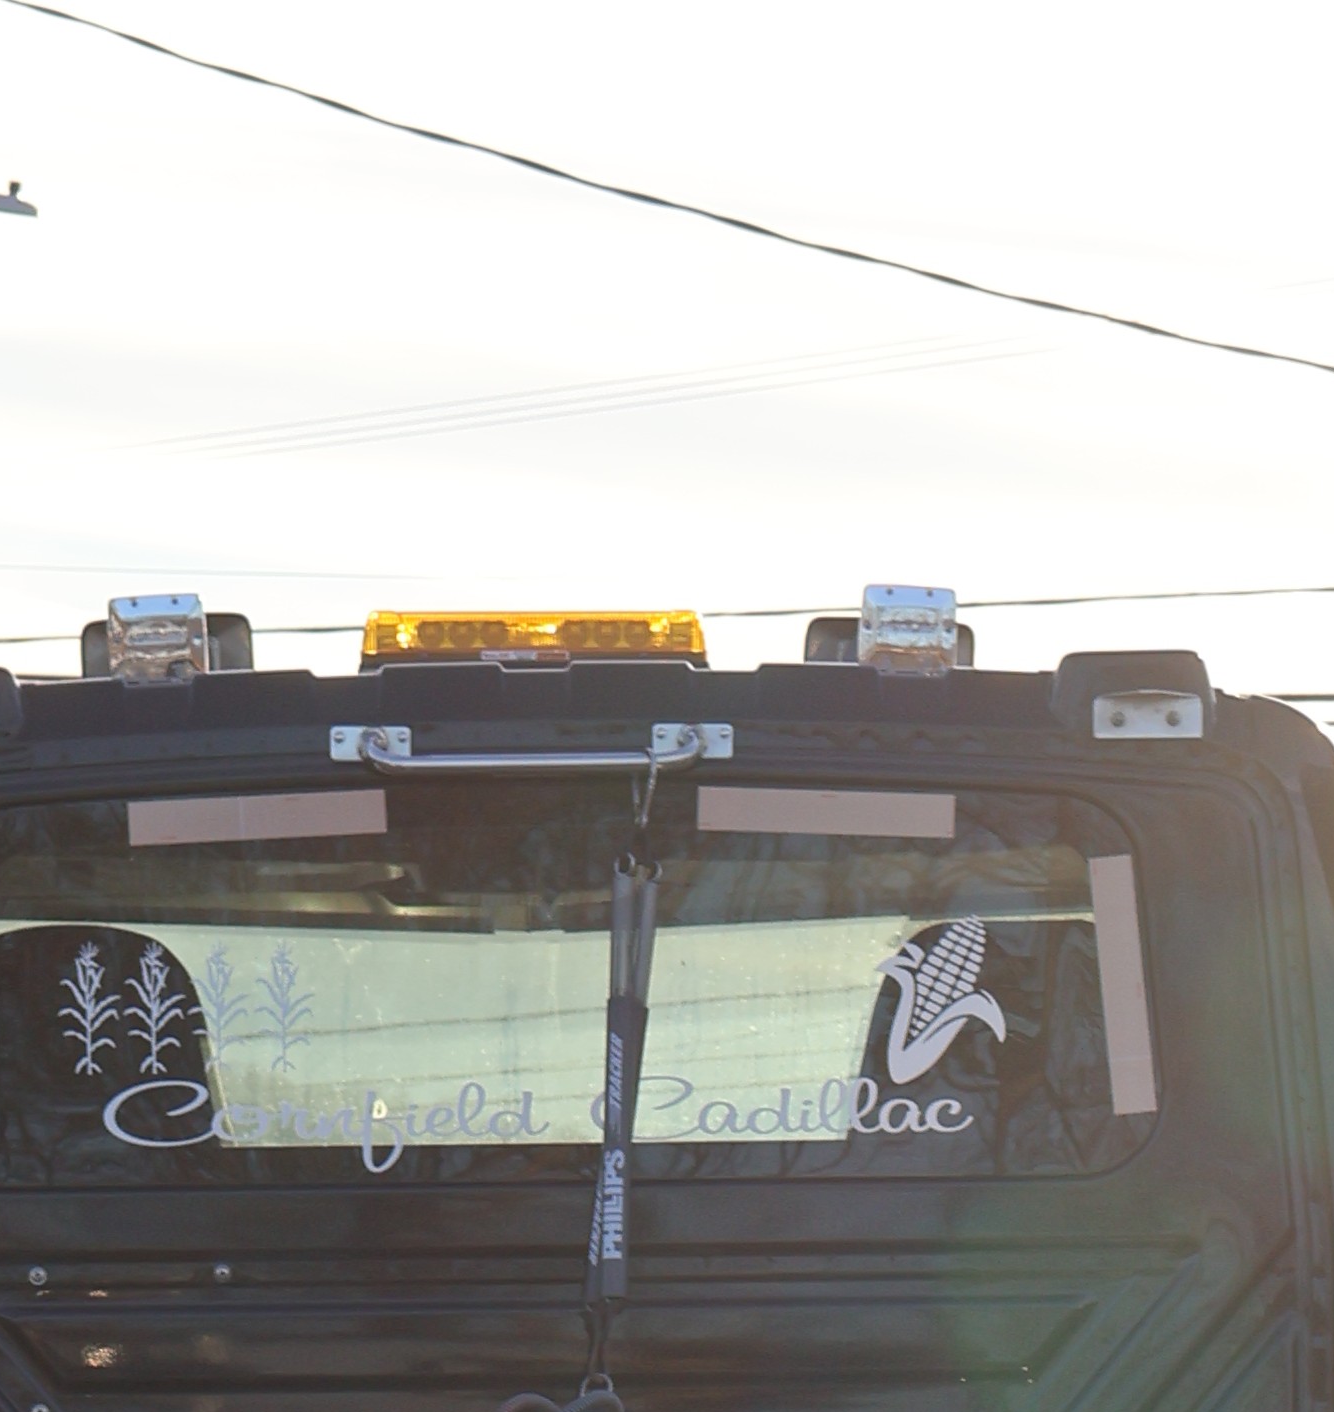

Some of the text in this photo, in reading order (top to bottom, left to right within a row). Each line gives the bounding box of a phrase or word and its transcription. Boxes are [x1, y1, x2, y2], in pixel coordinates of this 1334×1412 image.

[103, 1075, 974, 1174] Cornfield Cadillac
[601, 1149, 625, 1259] PHILLIPS
